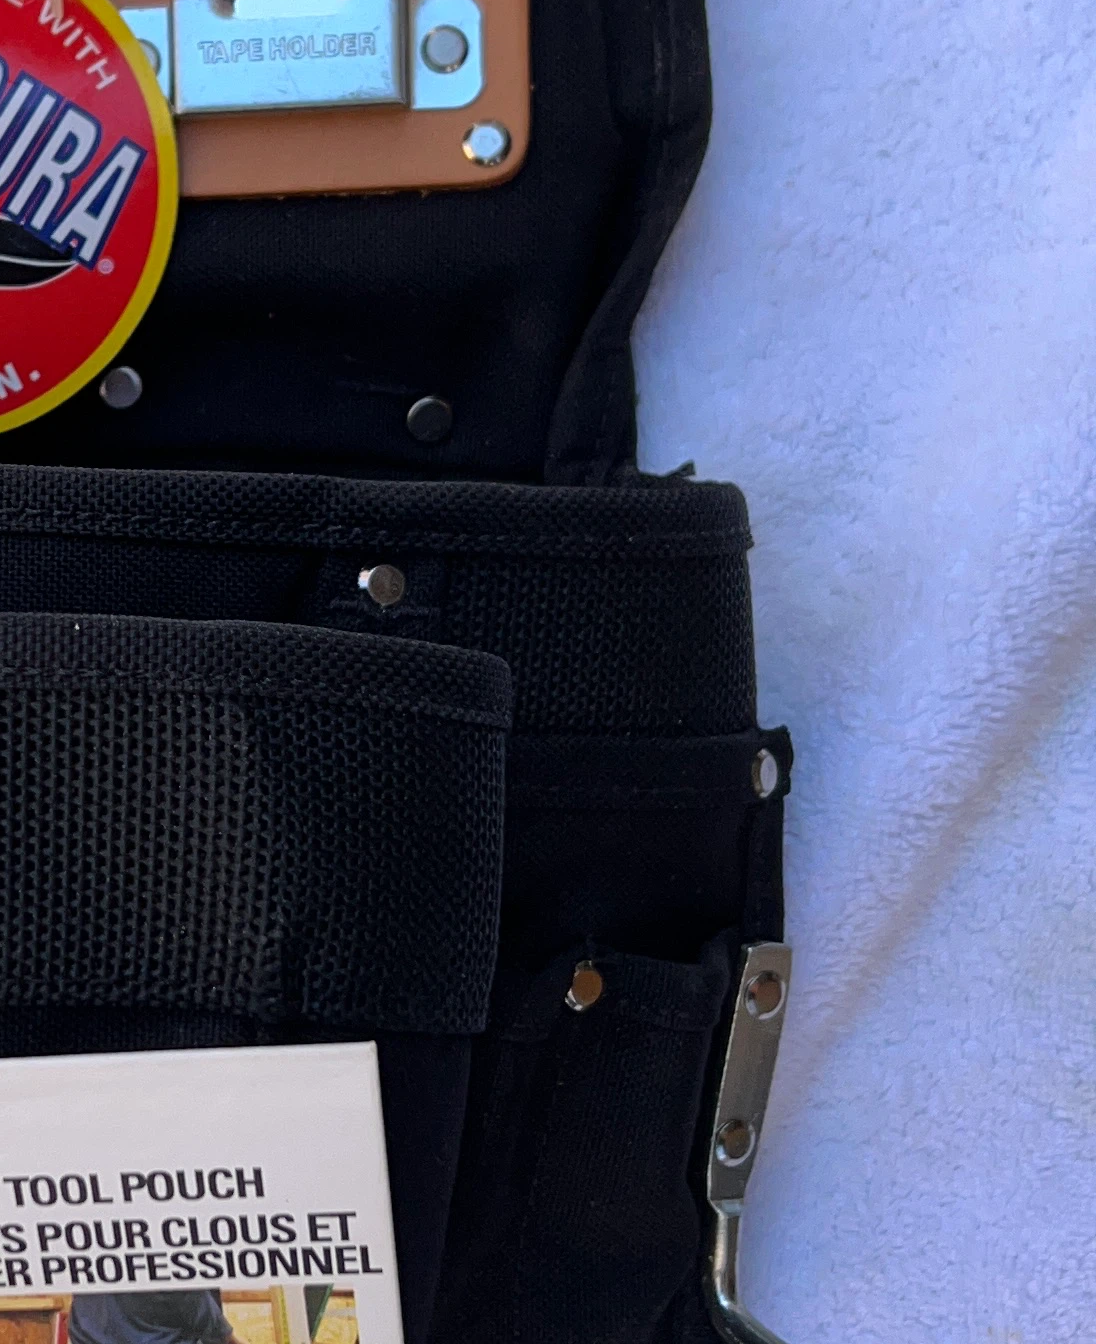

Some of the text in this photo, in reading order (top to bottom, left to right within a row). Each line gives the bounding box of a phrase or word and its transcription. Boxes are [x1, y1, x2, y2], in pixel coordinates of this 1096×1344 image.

[38, 0, 117, 90] WITH
[197, 32, 377, 65] TAPE HOLDER
[4, 1173, 113, 1208] TOOL
[120, 1167, 265, 1203] POUCH
[36, 1220, 152, 1251] POUR
[161, 1213, 297, 1247] CLOUS
[307, 1212, 356, 1242] ET
[43, 1244, 383, 1284] PROFESSIONNEL
